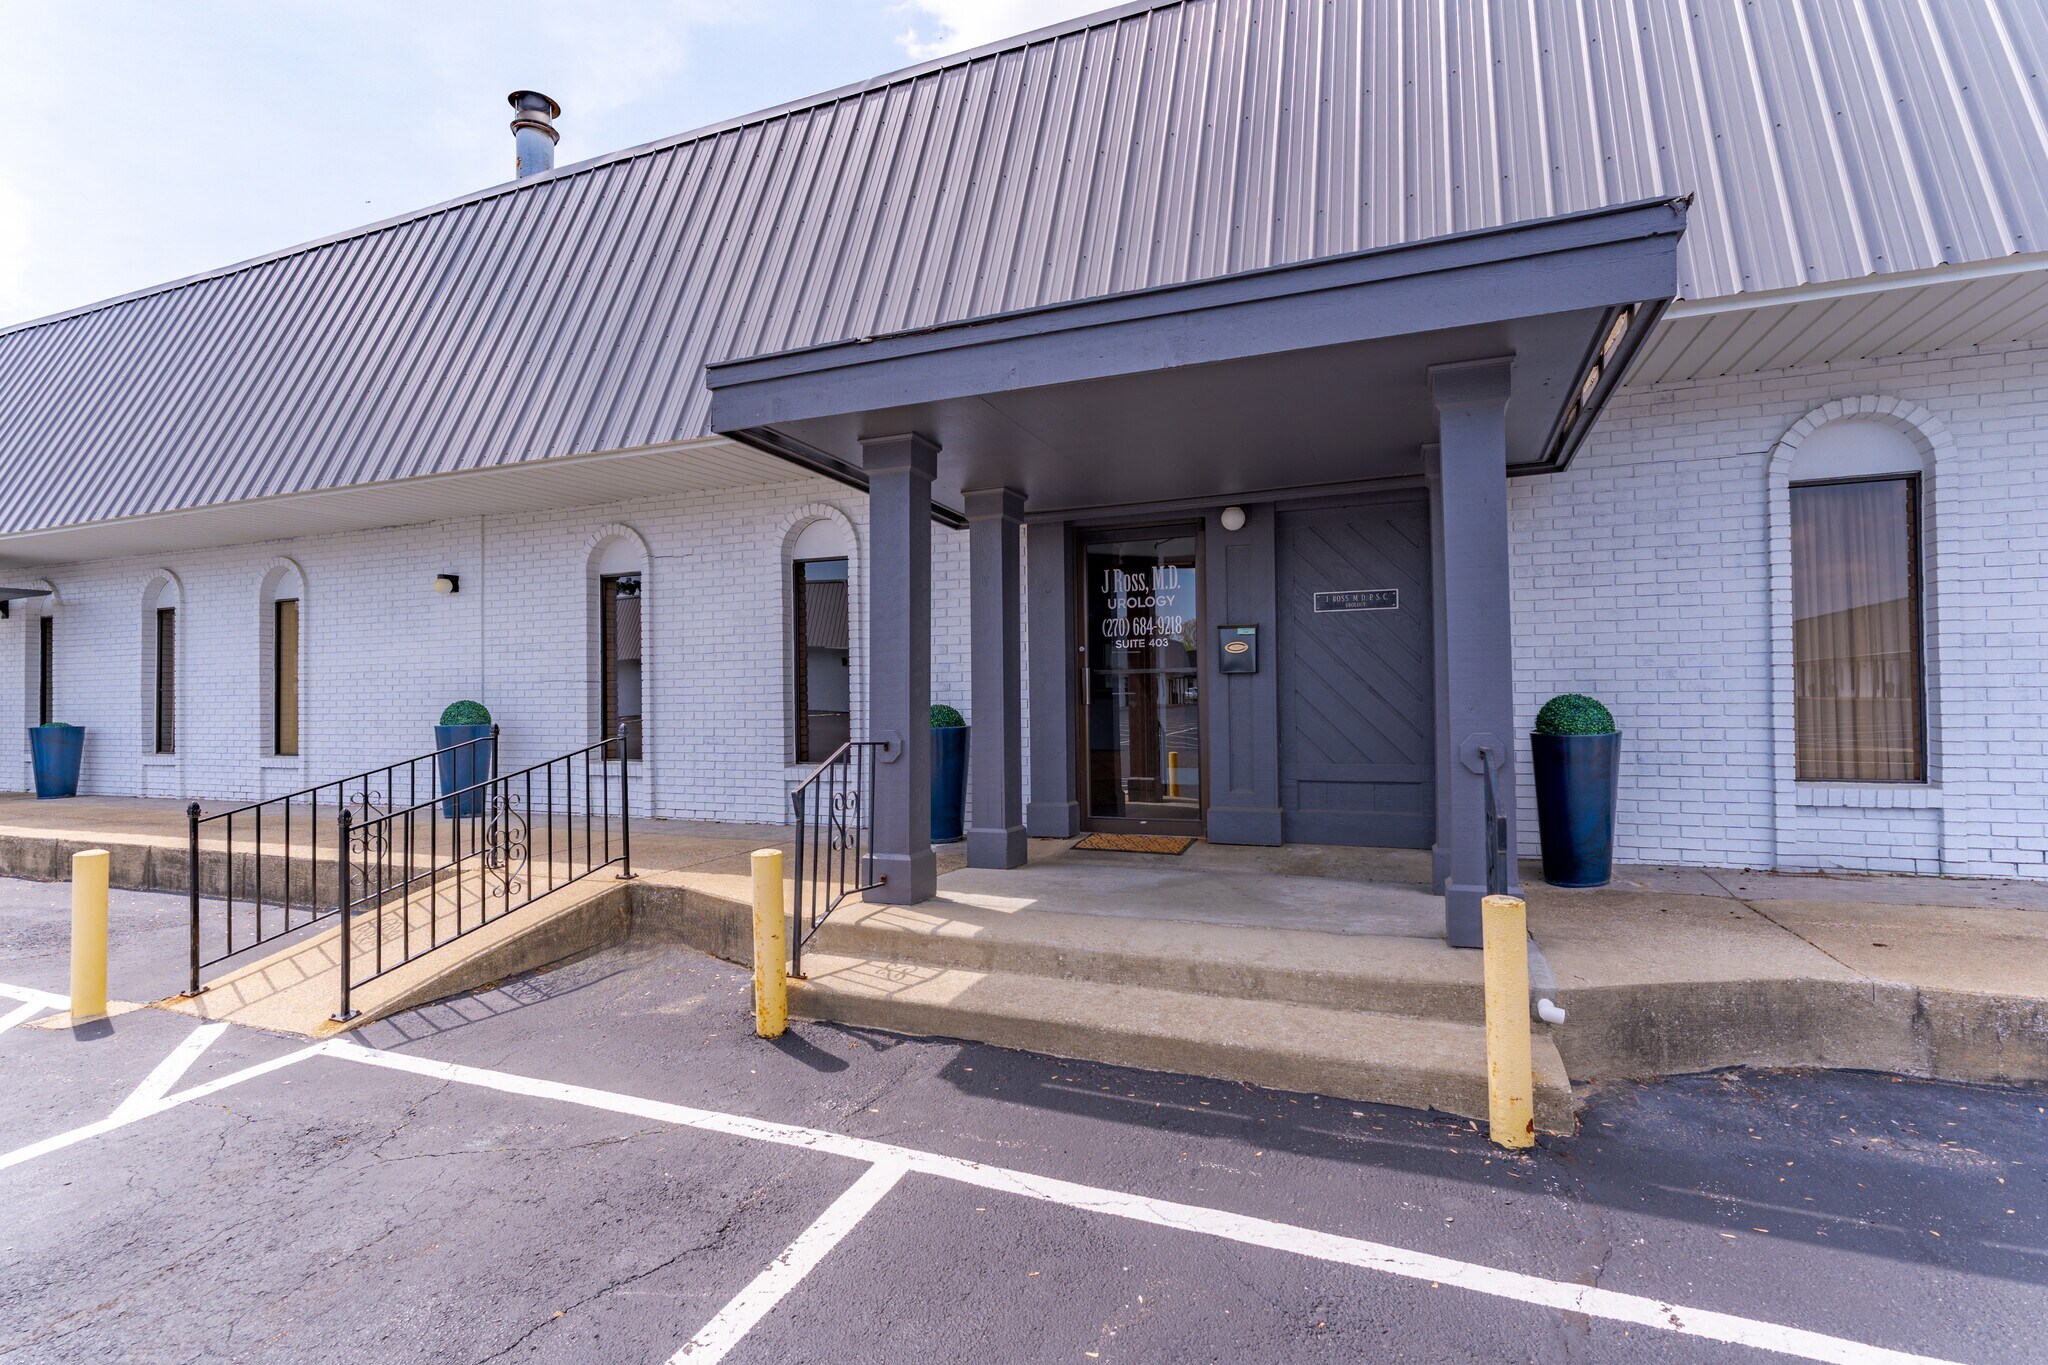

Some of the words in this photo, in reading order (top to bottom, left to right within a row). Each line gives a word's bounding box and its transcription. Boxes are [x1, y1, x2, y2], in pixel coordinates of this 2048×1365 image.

[1101, 569, 1110, 594] J
[1152, 565, 1181, 591] M.D.
[1107, 595, 1176, 610] UROLOGY
[1102, 618, 1130, 637] (270)
[1133, 616, 1182, 636] 684-9218
[1115, 639, 1145, 649] SUITE
[1148, 638, 1169, 647] 403
